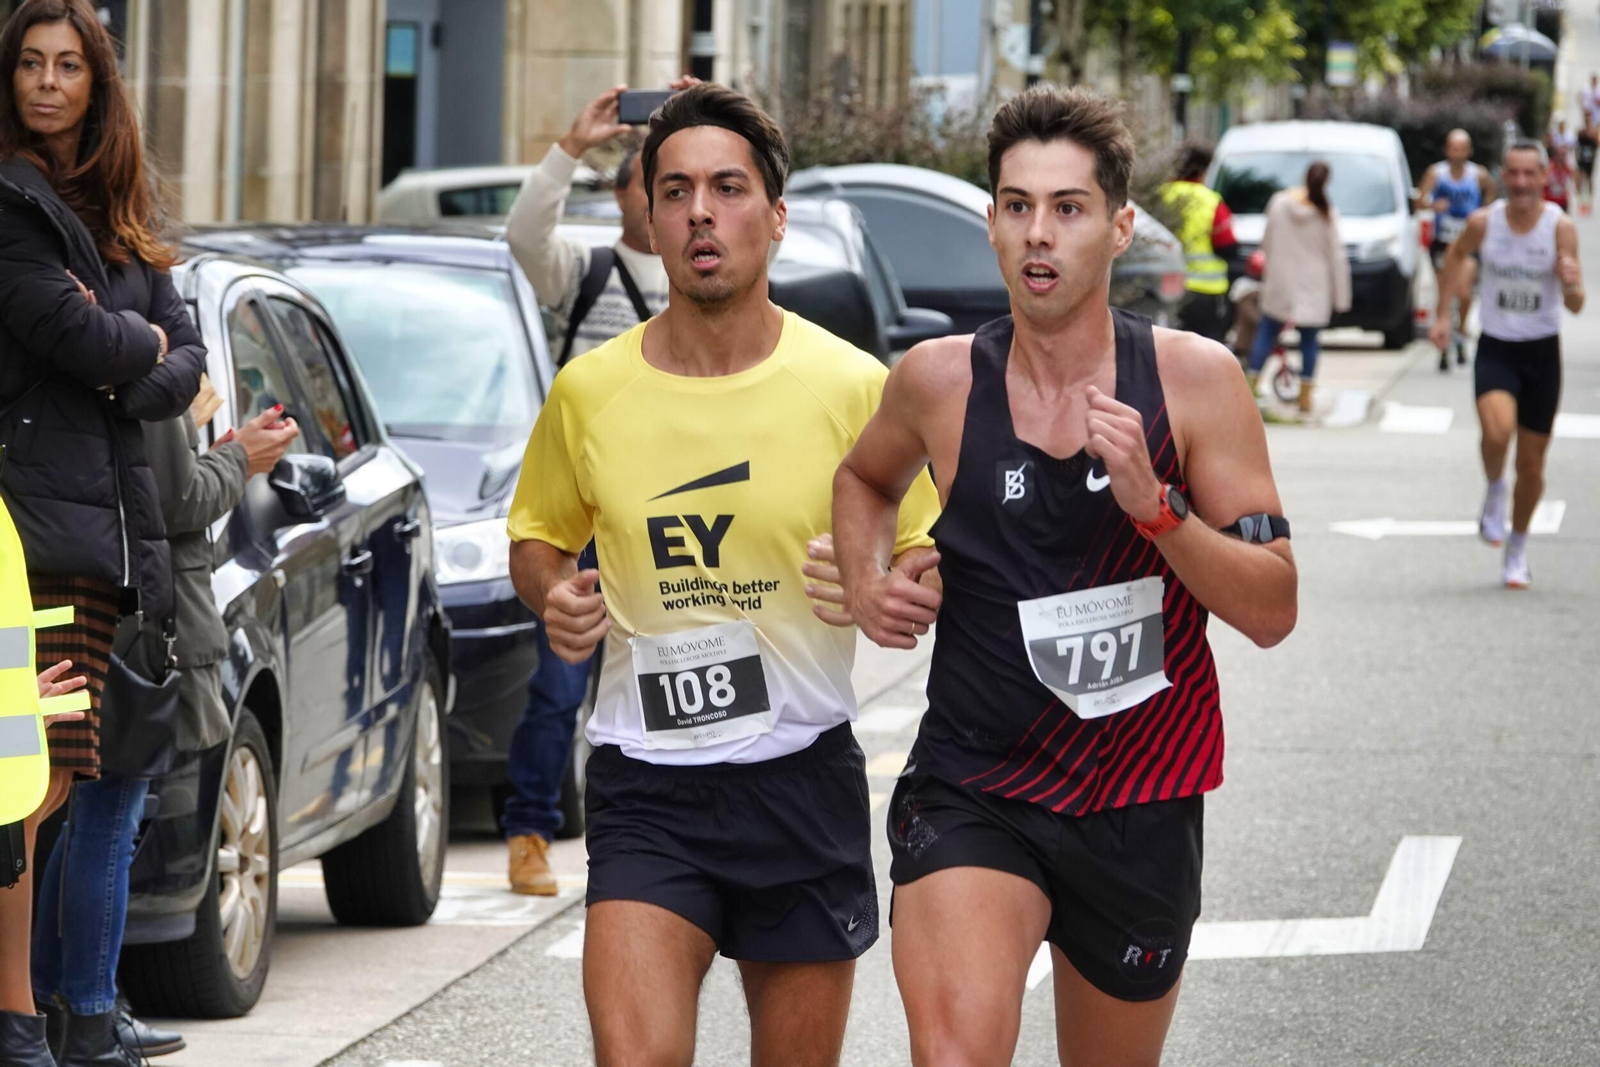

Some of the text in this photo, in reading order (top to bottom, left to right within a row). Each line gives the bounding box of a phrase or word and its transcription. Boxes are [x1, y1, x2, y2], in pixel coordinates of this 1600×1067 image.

[646, 514, 735, 570] EY
[659, 577, 723, 595] Building
[733, 579, 780, 595] better
[662, 592, 762, 611] working orld
[1056, 595, 1133, 619] EU MÓVOME
[1058, 620, 1075, 628] POLA
[656, 635, 726, 657] EU MÓVOME
[1056, 621, 1143, 686] 797
[658, 664, 736, 716] 108
[676, 717, 692, 726] David
